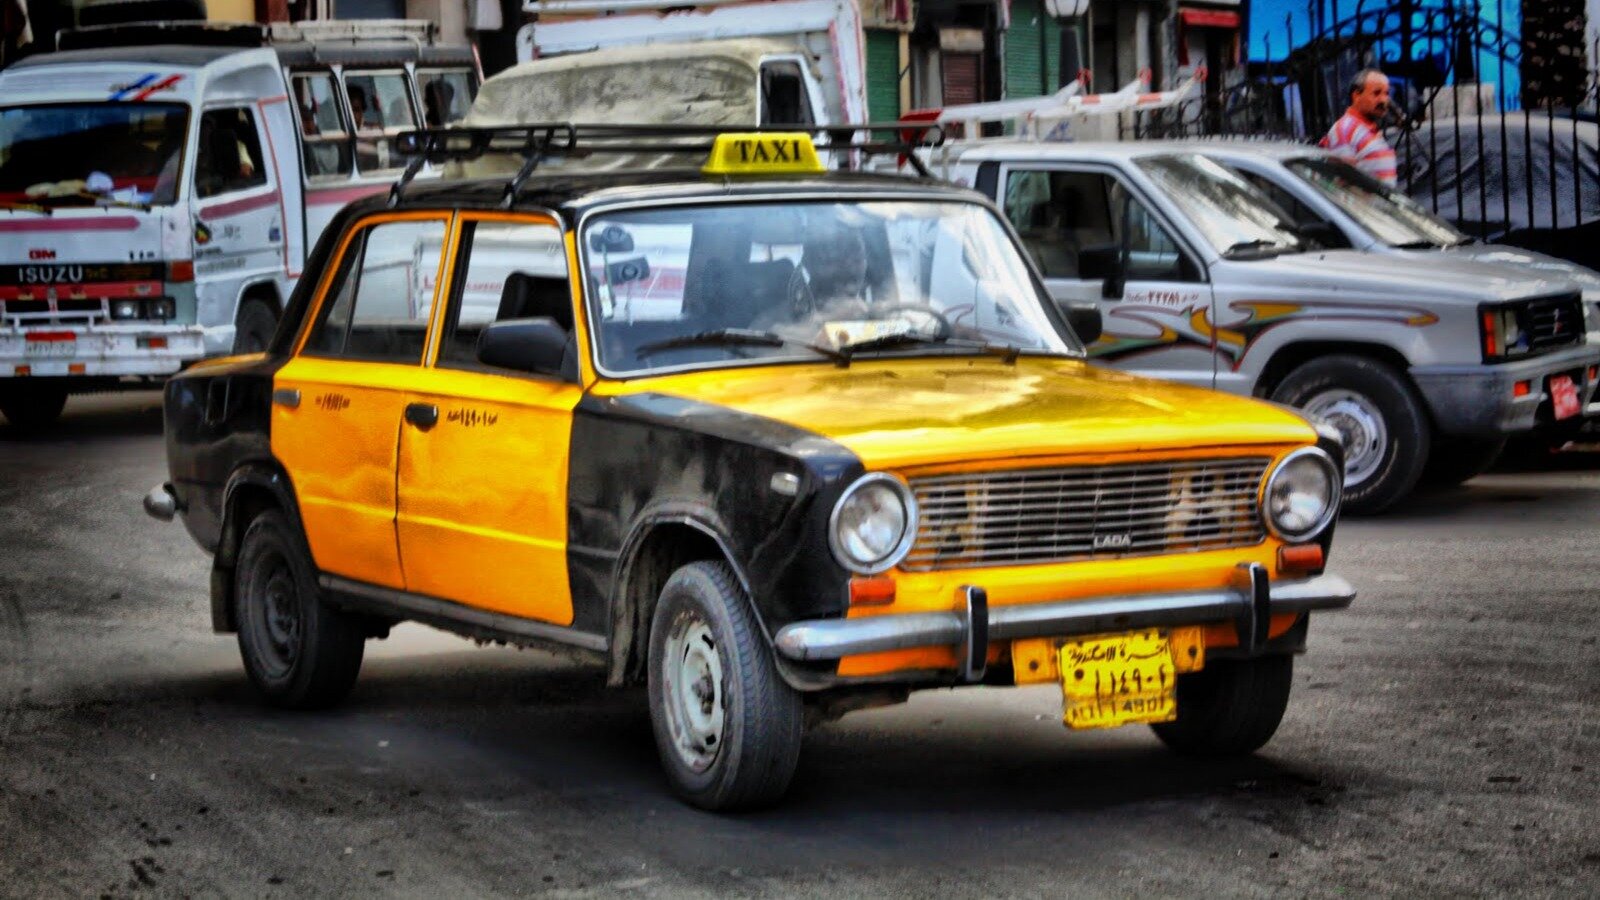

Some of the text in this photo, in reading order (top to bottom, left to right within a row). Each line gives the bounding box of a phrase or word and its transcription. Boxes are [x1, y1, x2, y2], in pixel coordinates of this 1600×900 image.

[733, 139, 802, 163] TAXI
[18, 265, 83, 282] ISUZU
[1093, 533, 1132, 548] LADA
